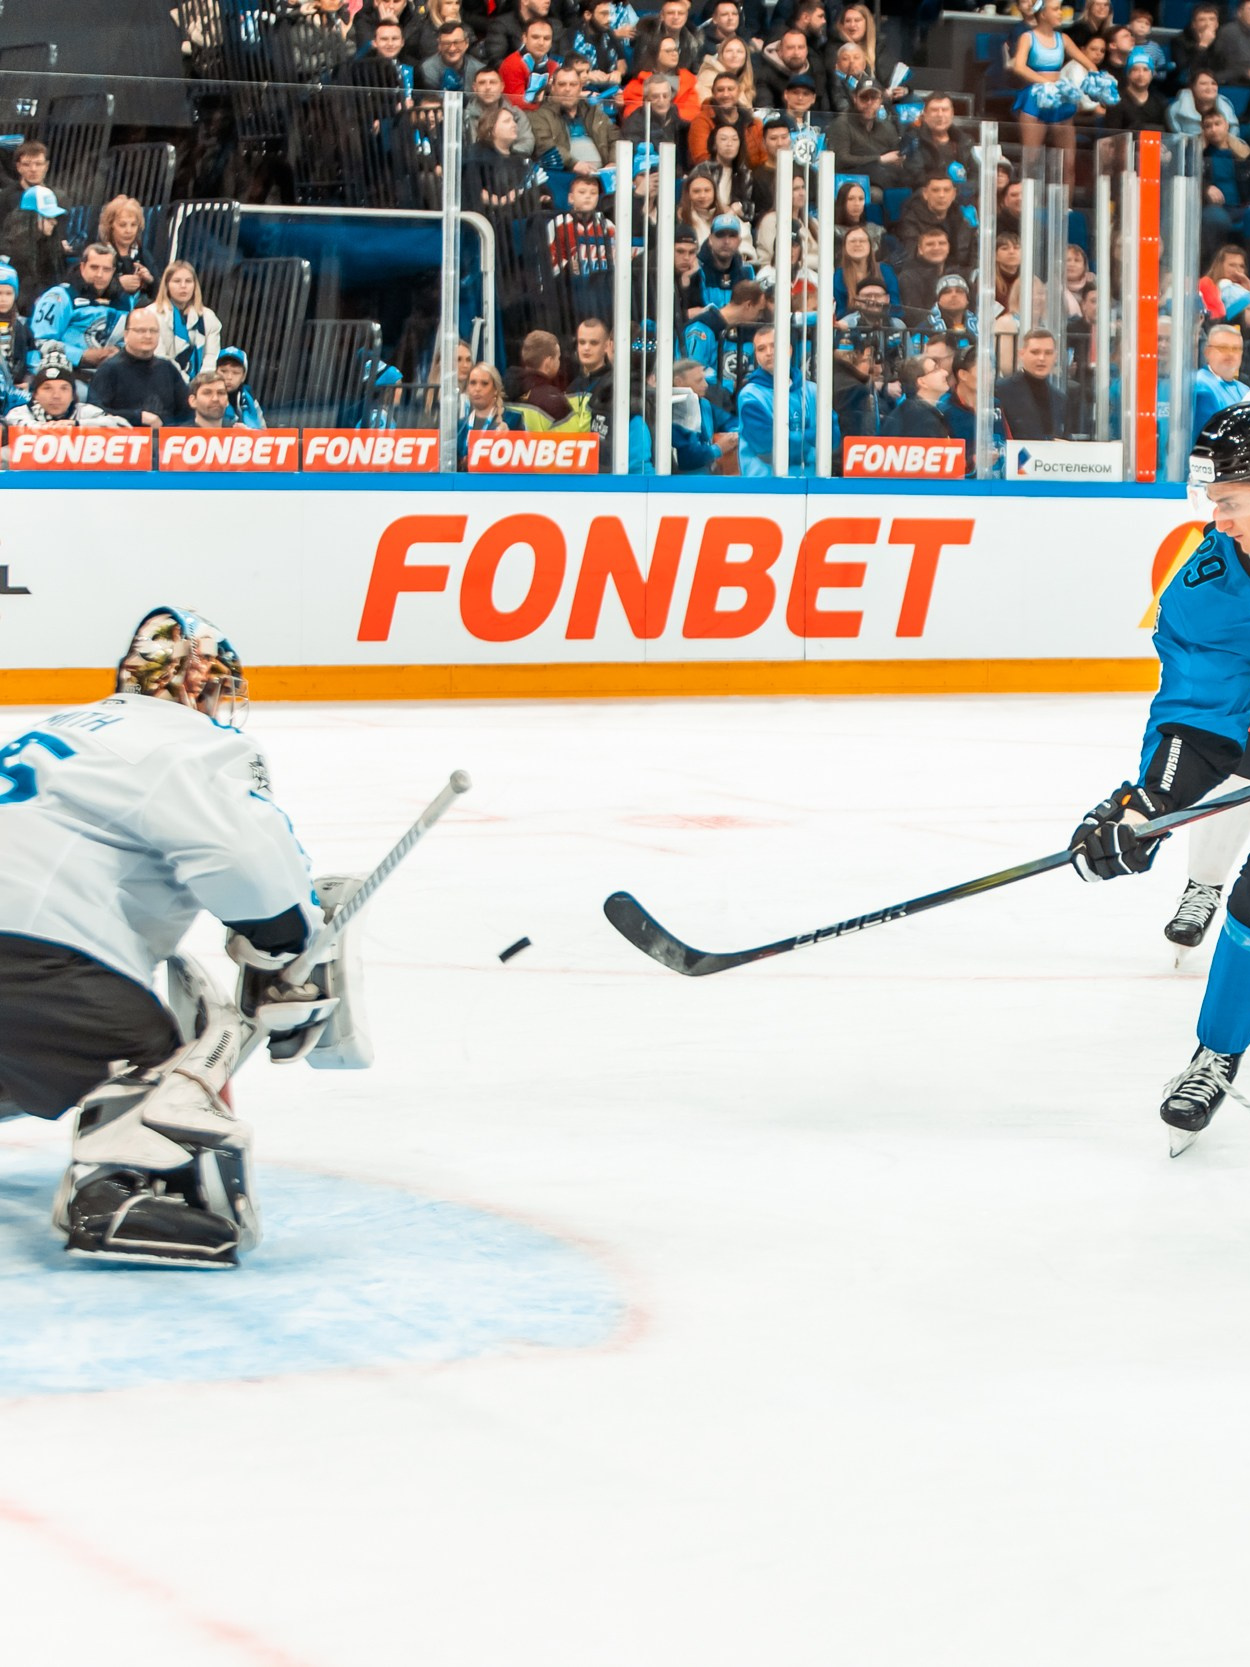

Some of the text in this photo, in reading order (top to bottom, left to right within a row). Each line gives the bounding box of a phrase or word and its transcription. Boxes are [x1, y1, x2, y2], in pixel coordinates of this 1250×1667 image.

[12, 435, 150, 464] FONBET
[161, 436, 296, 465] FONBET
[305, 436, 438, 465] FONBET
[470, 439, 597, 467] FONBET
[845, 443, 963, 473] FONBET
[1034, 459, 1113, 474] Ростелеком
[357, 513, 976, 643] FONBET
[1160, 734, 1183, 791] NOVOSIBIR
